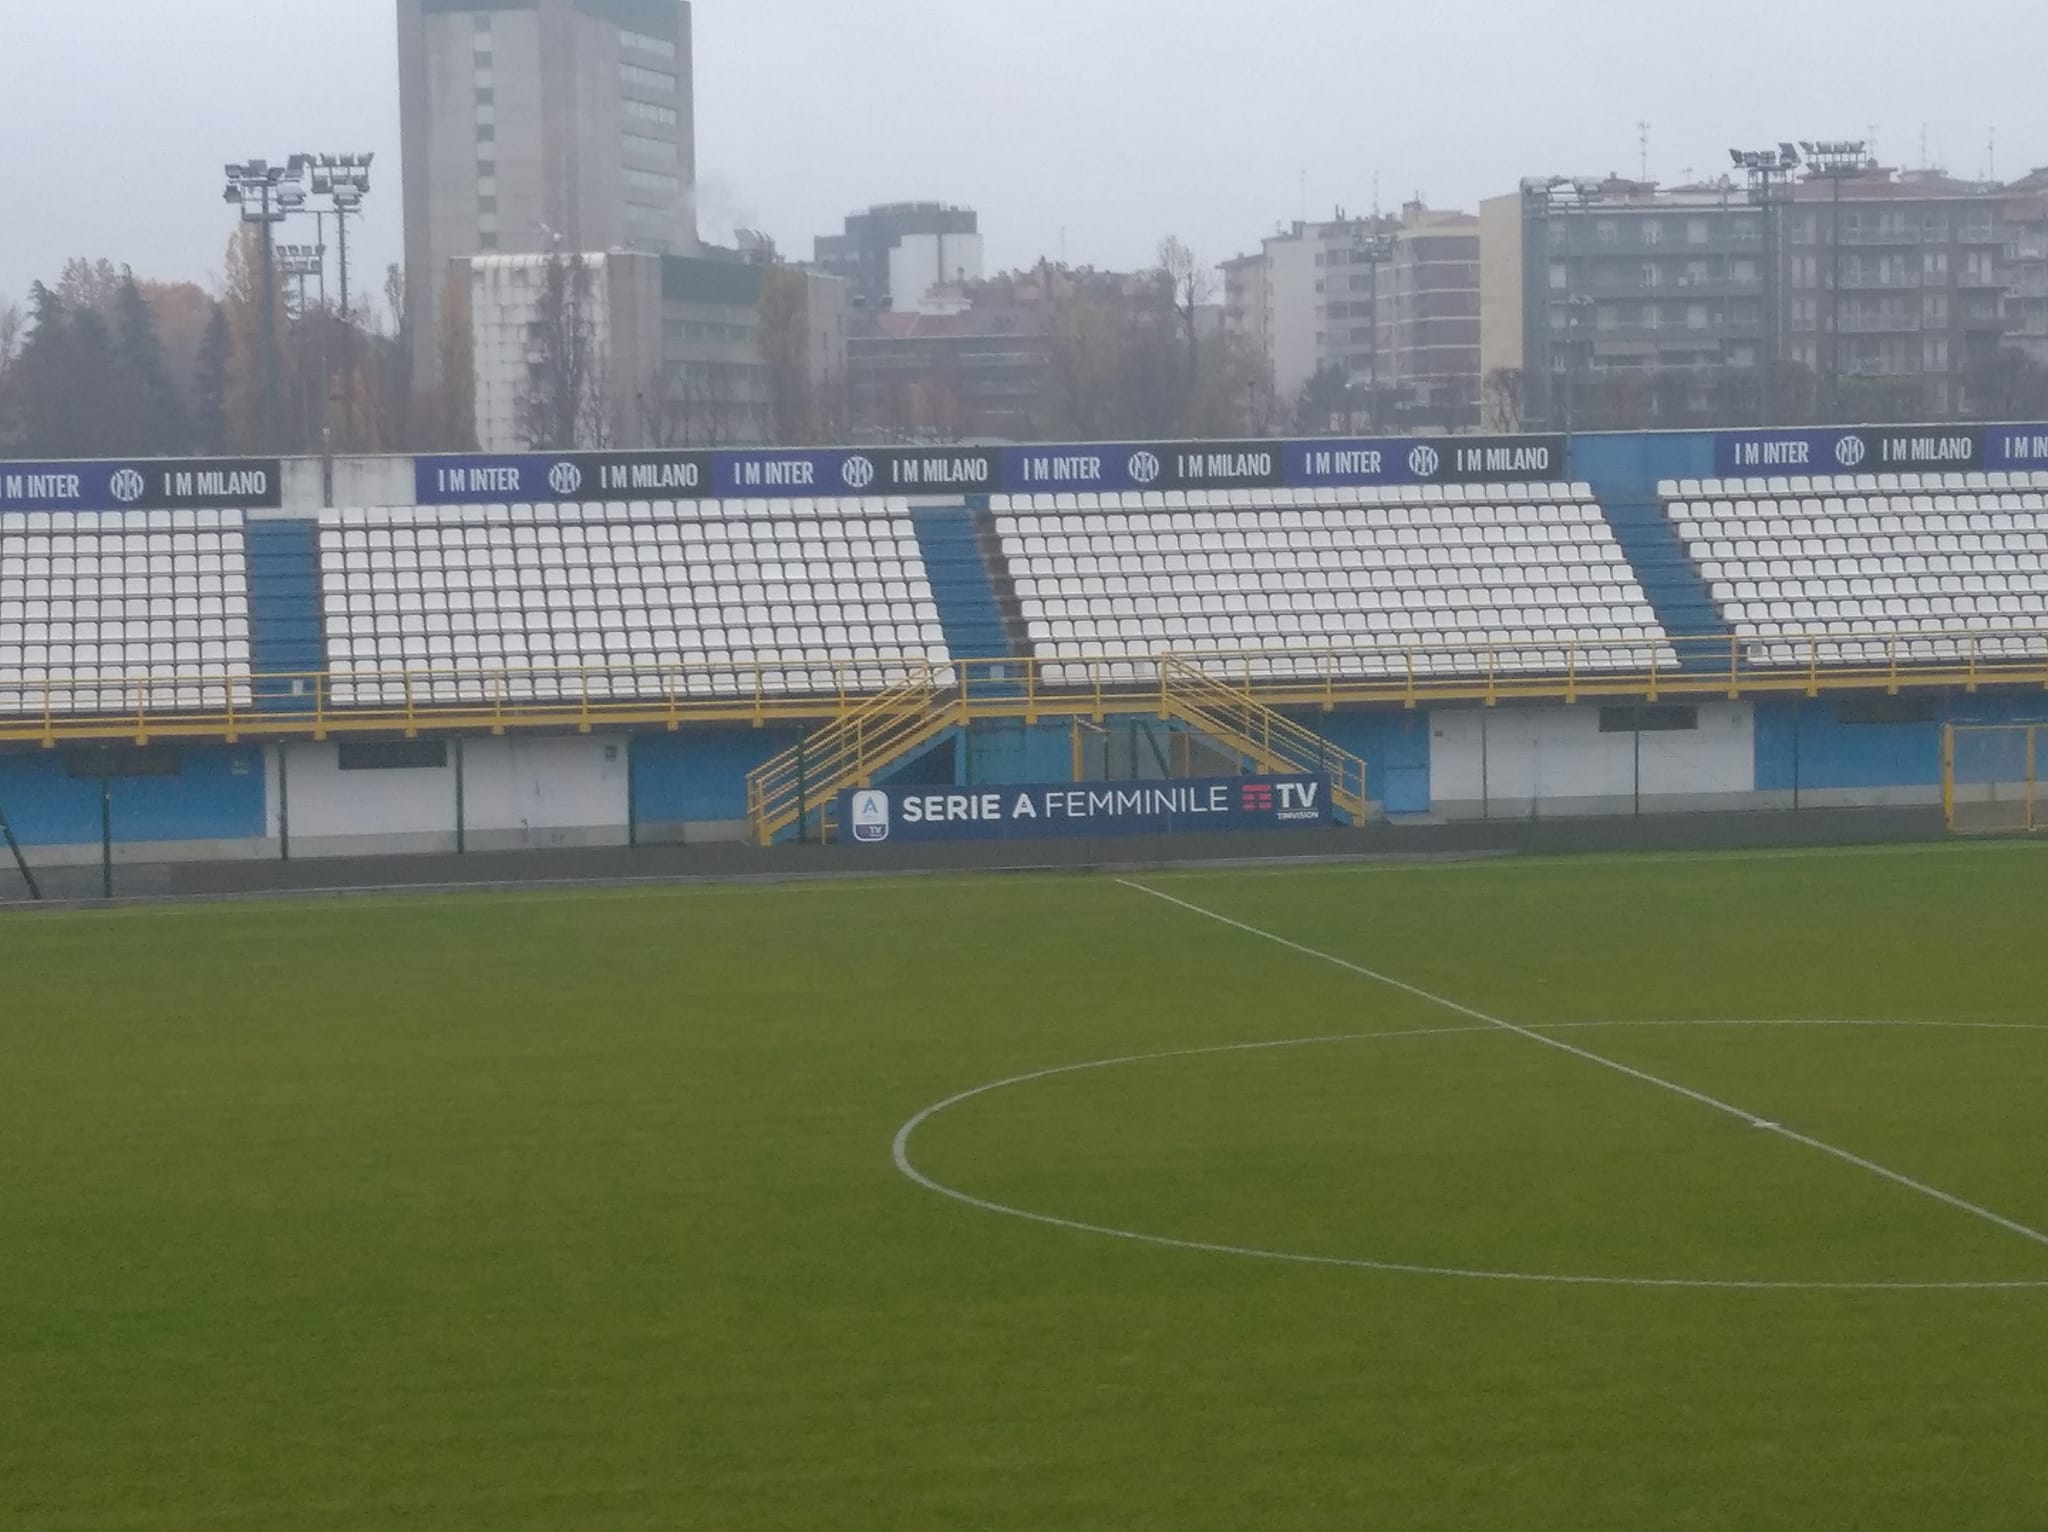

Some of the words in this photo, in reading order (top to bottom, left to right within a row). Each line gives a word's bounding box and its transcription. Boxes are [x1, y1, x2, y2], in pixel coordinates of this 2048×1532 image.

[1457, 450, 1462, 471] I
[1468, 449, 1481, 471] M
[1487, 447, 1548, 471] MILANO
[1735, 443, 1740, 464] I
[1745, 443, 1758, 464] M
[1764, 441, 1809, 464] INTER
[1883, 439, 1888, 461] I
[1893, 439, 1906, 460] M
[1912, 437, 1972, 460] MILANO
[2005, 437, 2010, 458] I
[2015, 437, 2028, 458] M
[735, 463, 740, 485] I
[746, 462, 760, 485] M
[766, 461, 814, 485] INTER
[893, 460, 898, 482] I
[904, 460, 918, 482] M
[924, 459, 988, 482] MILANO
[1024, 458, 1029, 480] I
[1034, 458, 1048, 480] M
[1054, 457, 1101, 480] INTER
[1178, 456, 1183, 477] I
[1189, 455, 1203, 477] M
[1208, 453, 1271, 477] MILANO
[1306, 453, 1311, 474] I
[1316, 452, 1330, 474] M
[1335, 451, 1381, 474] INTER
[7, 475, 22, 498] M
[28, 474, 80, 498] INTER
[165, 473, 170, 496] I
[176, 473, 192, 496] M
[197, 471, 266, 496] MILANO
[438, 470, 444, 492] I
[450, 469, 465, 492] M
[470, 468, 520, 491] INTER
[601, 466, 607, 489] I
[612, 465, 627, 488] M
[632, 463, 698, 488] MILANO
[902, 795, 1001, 822] SERIE
[1012, 793, 1037, 819] A
[1046, 786, 1229, 818] FEMMINILE
[1276, 782, 1318, 808] TV
